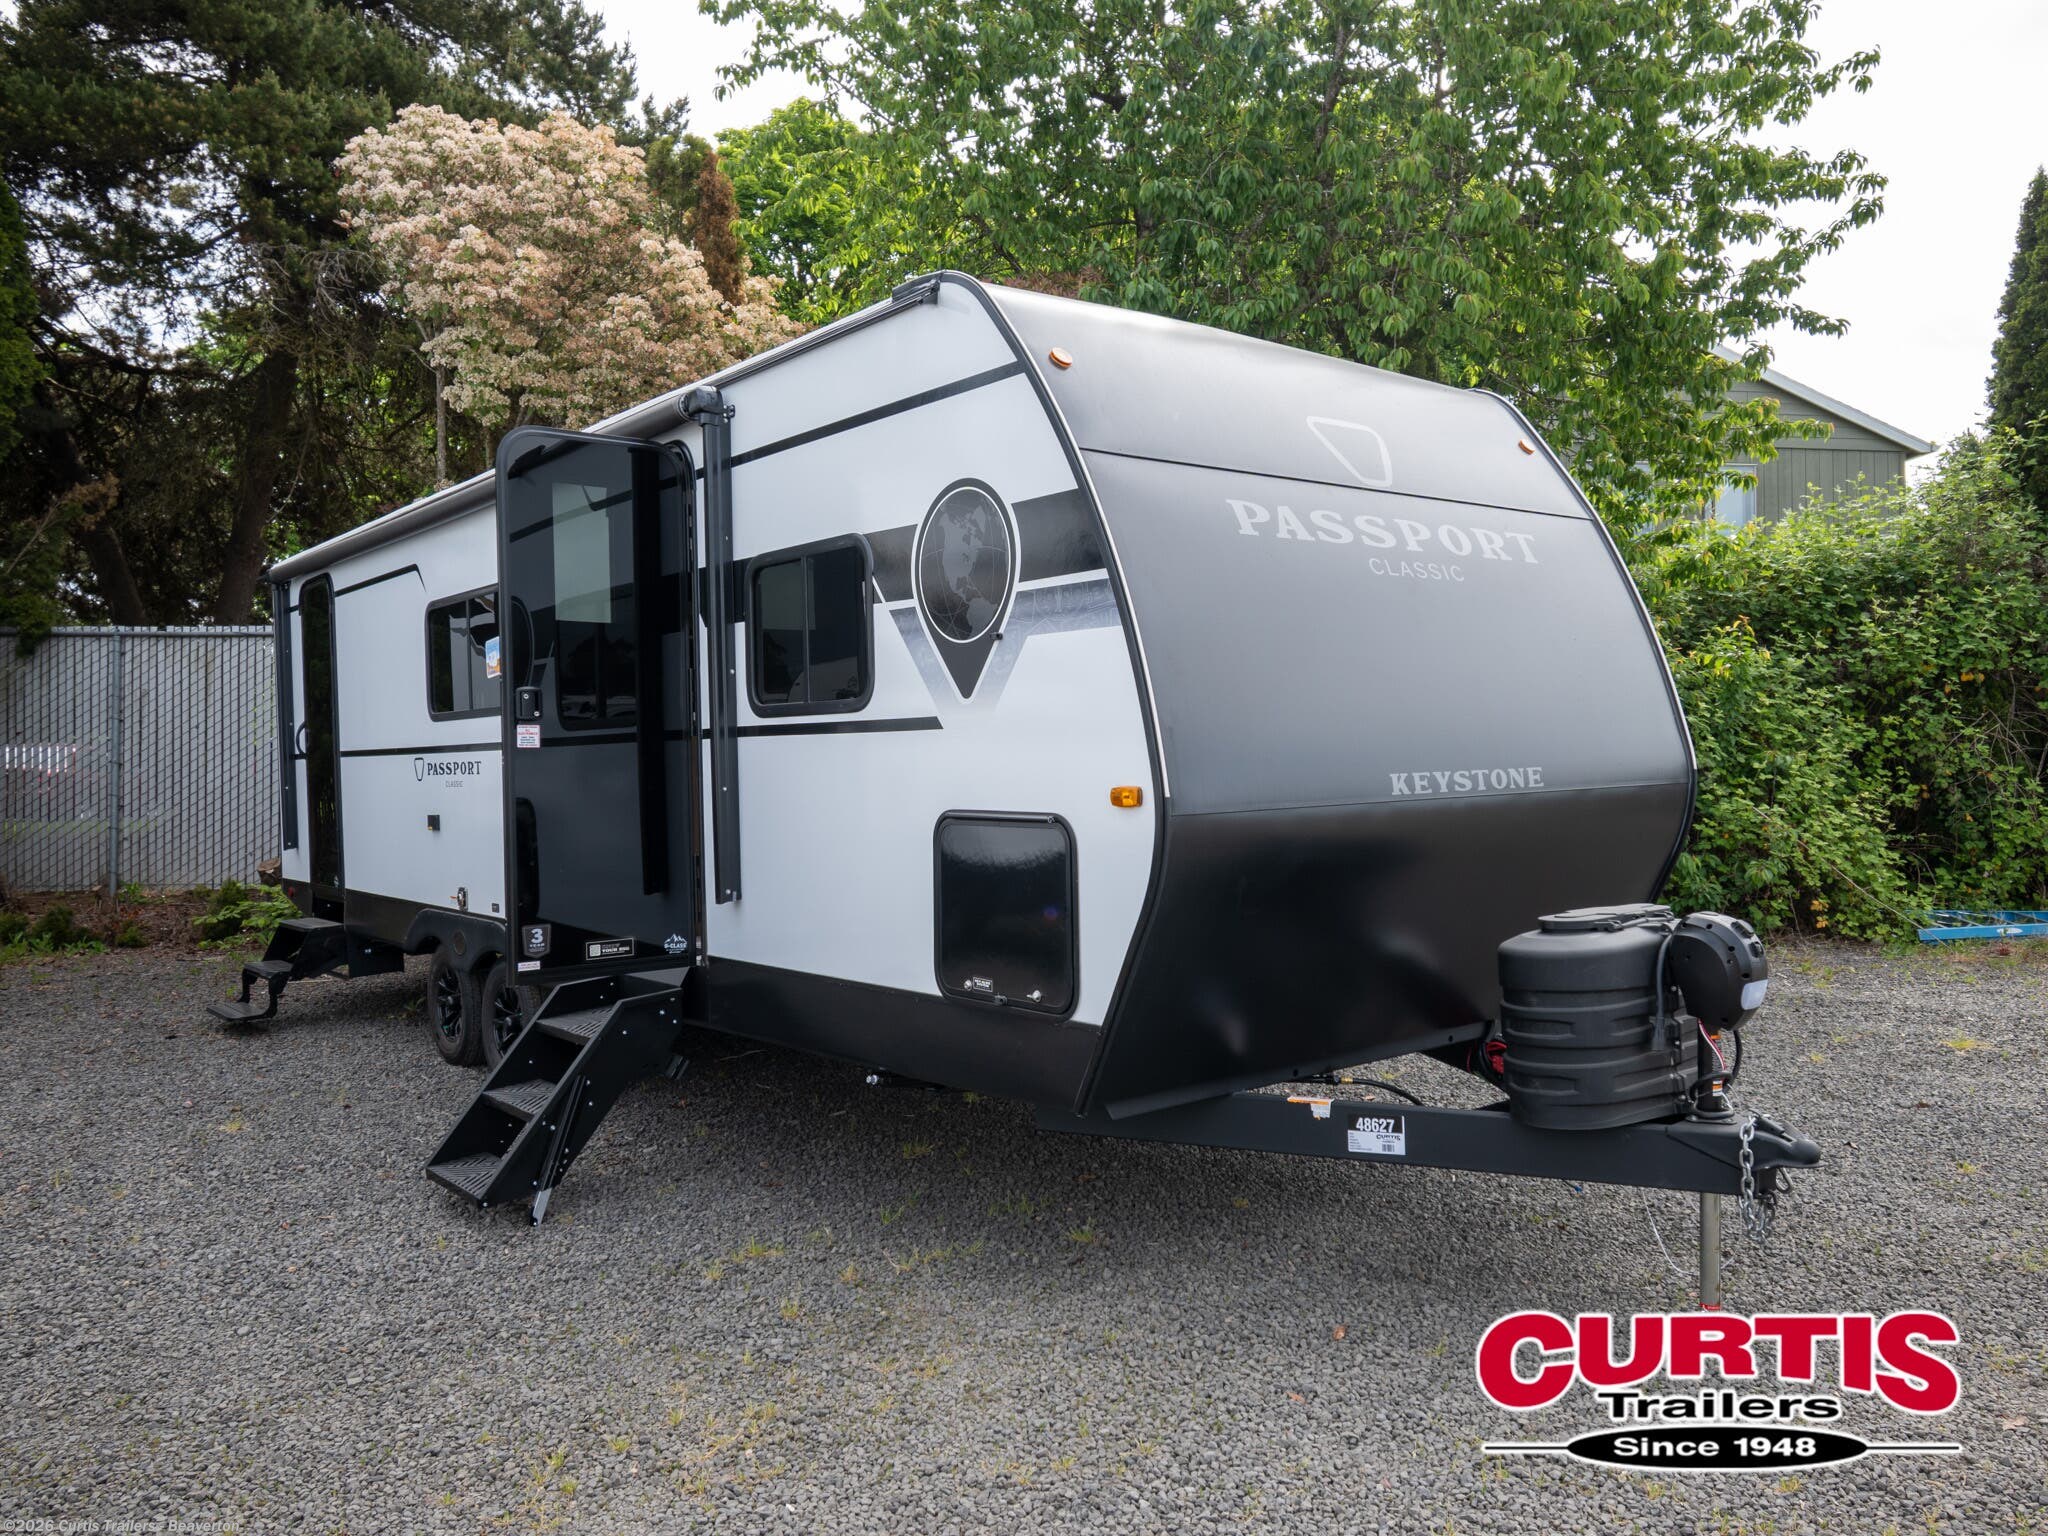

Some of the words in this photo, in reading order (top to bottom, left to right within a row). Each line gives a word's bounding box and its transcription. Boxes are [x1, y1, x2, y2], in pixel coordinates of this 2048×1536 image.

[1225, 498, 1539, 564] PASSPORT
[1368, 557, 1465, 582] CLASSIC
[427, 761, 482, 776] PASSPORT
[1389, 766, 1545, 796] KEYSTONE
[530, 928, 544, 944] 3
[1355, 1117, 1395, 1133] 48627
